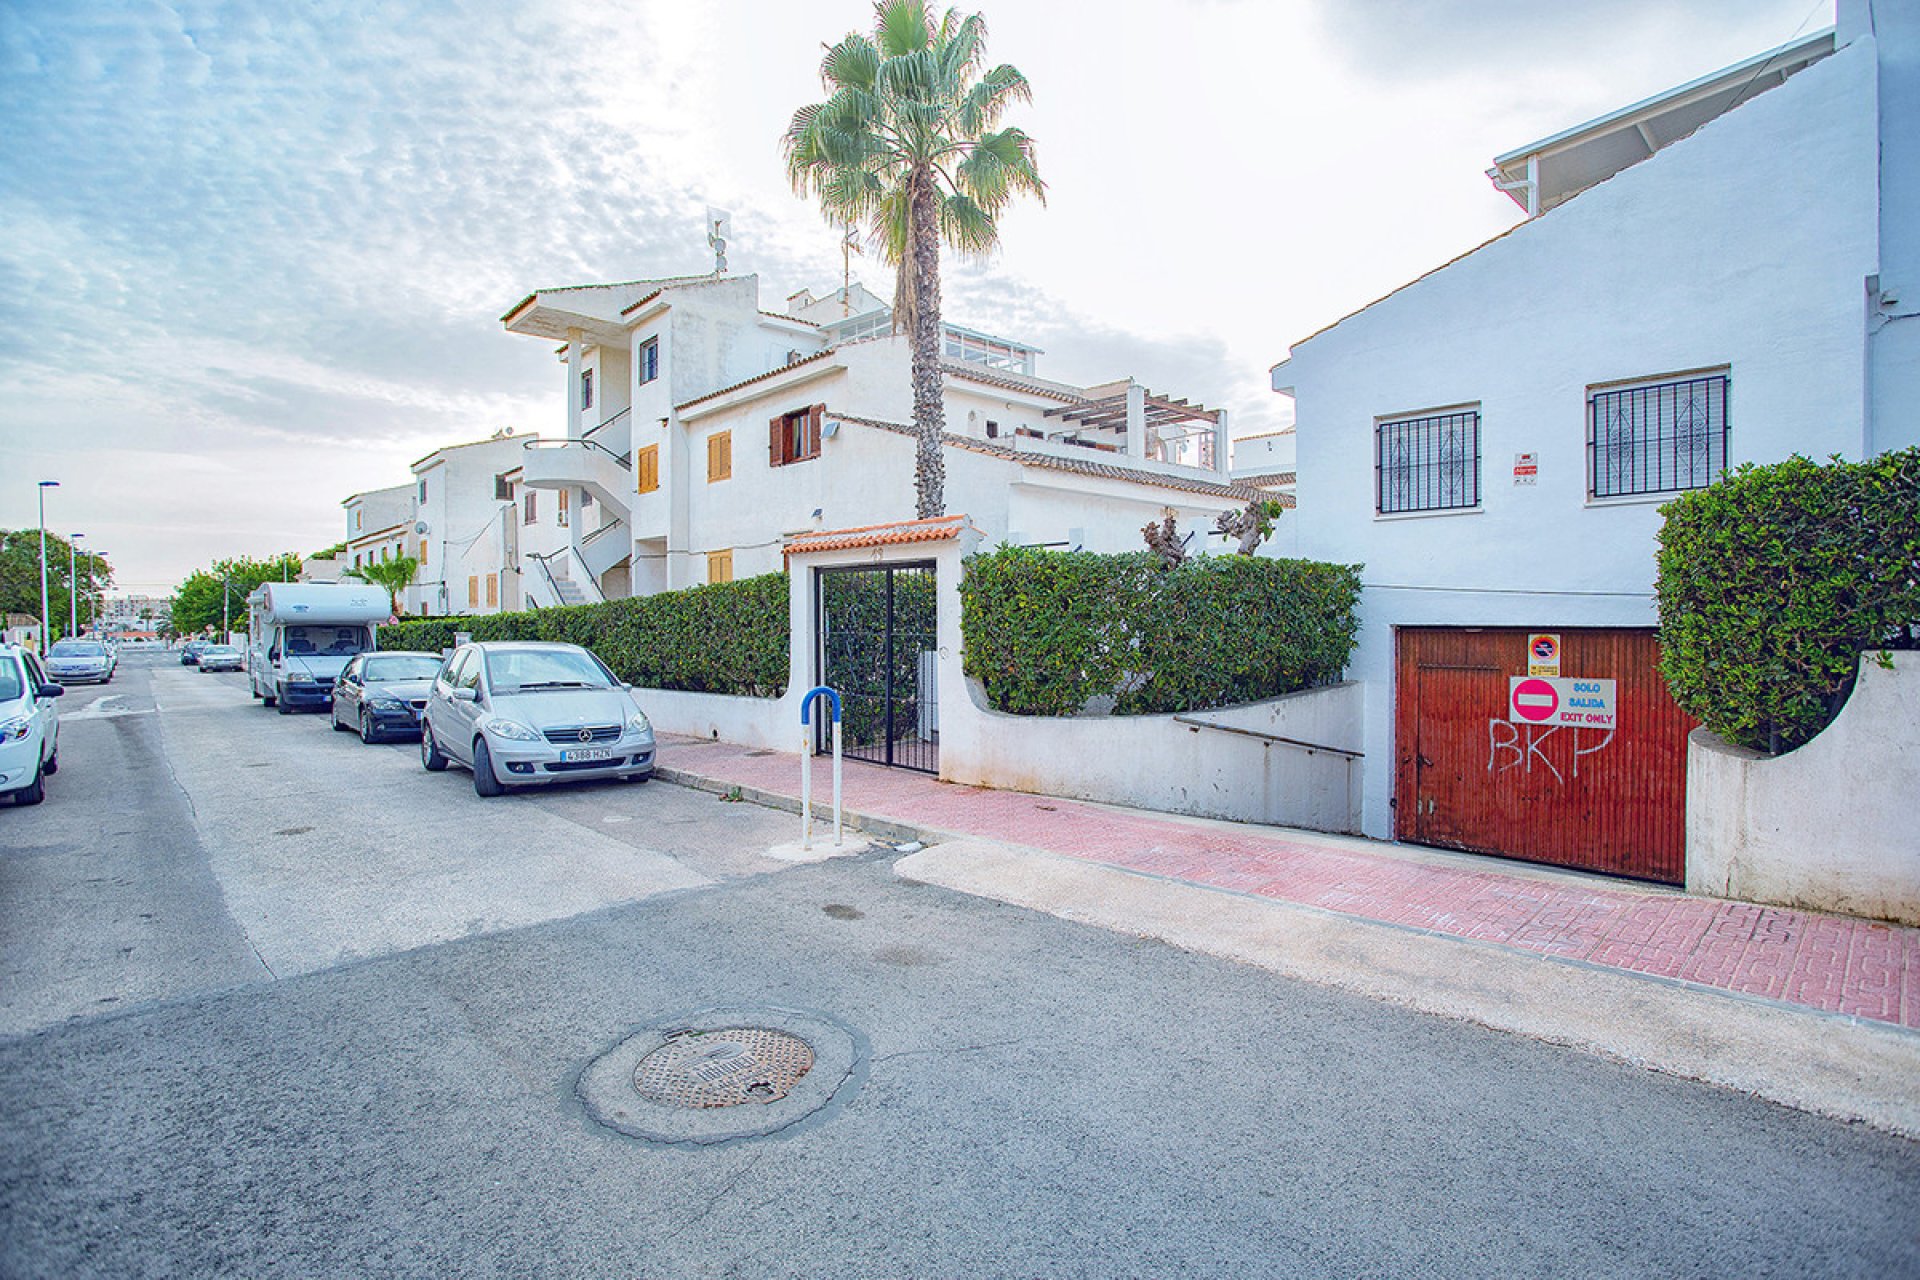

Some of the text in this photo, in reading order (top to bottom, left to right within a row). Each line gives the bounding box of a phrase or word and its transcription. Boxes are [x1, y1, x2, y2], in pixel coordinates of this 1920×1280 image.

[1573, 682, 1601, 693] SOLO
[1568, 697, 1605, 708] SALIDA
[1560, 712, 1613, 724] EXIT ONLY
